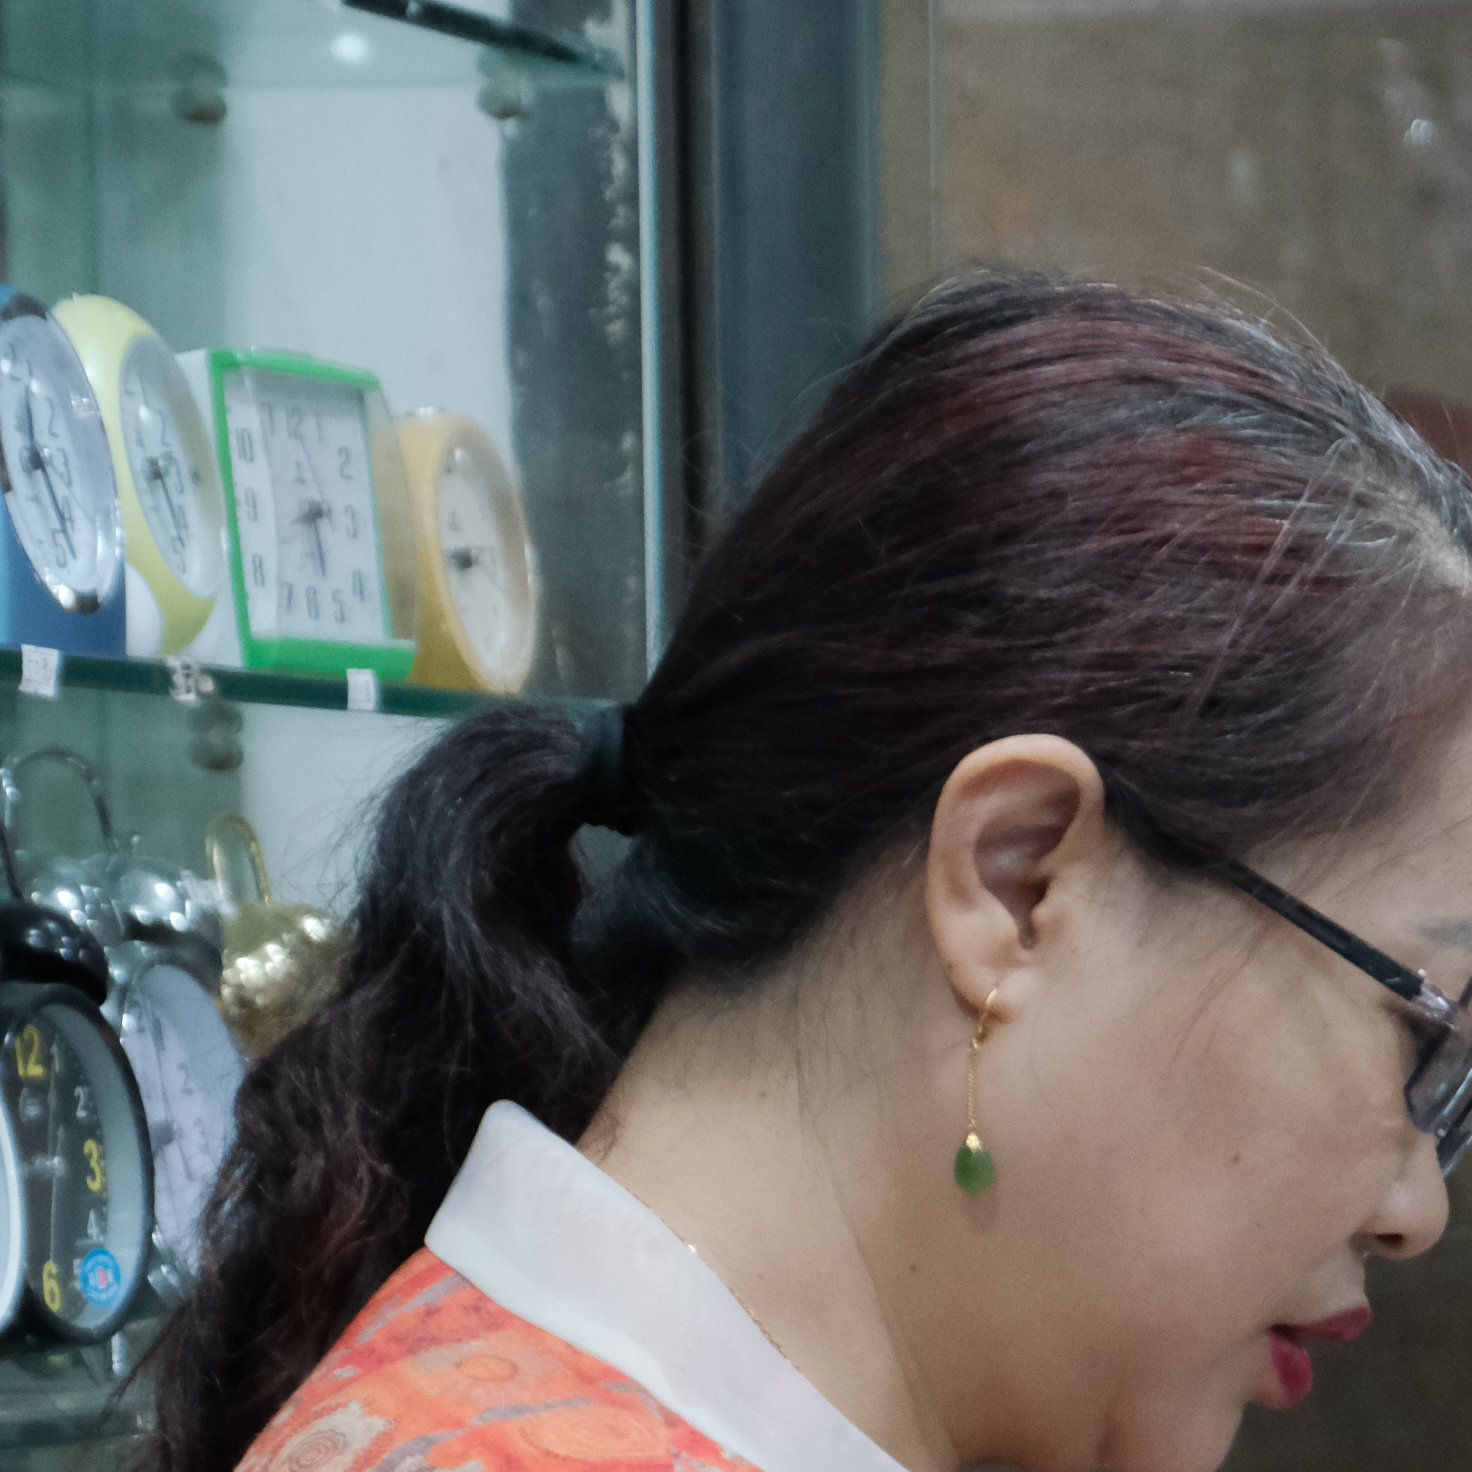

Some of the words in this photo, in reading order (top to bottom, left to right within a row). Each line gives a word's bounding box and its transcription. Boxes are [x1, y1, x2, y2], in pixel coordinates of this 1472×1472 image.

[14, 1024, 46, 1080] 12
[83, 1138, 105, 1194] 3
[41, 1259, 62, 1314] 6
